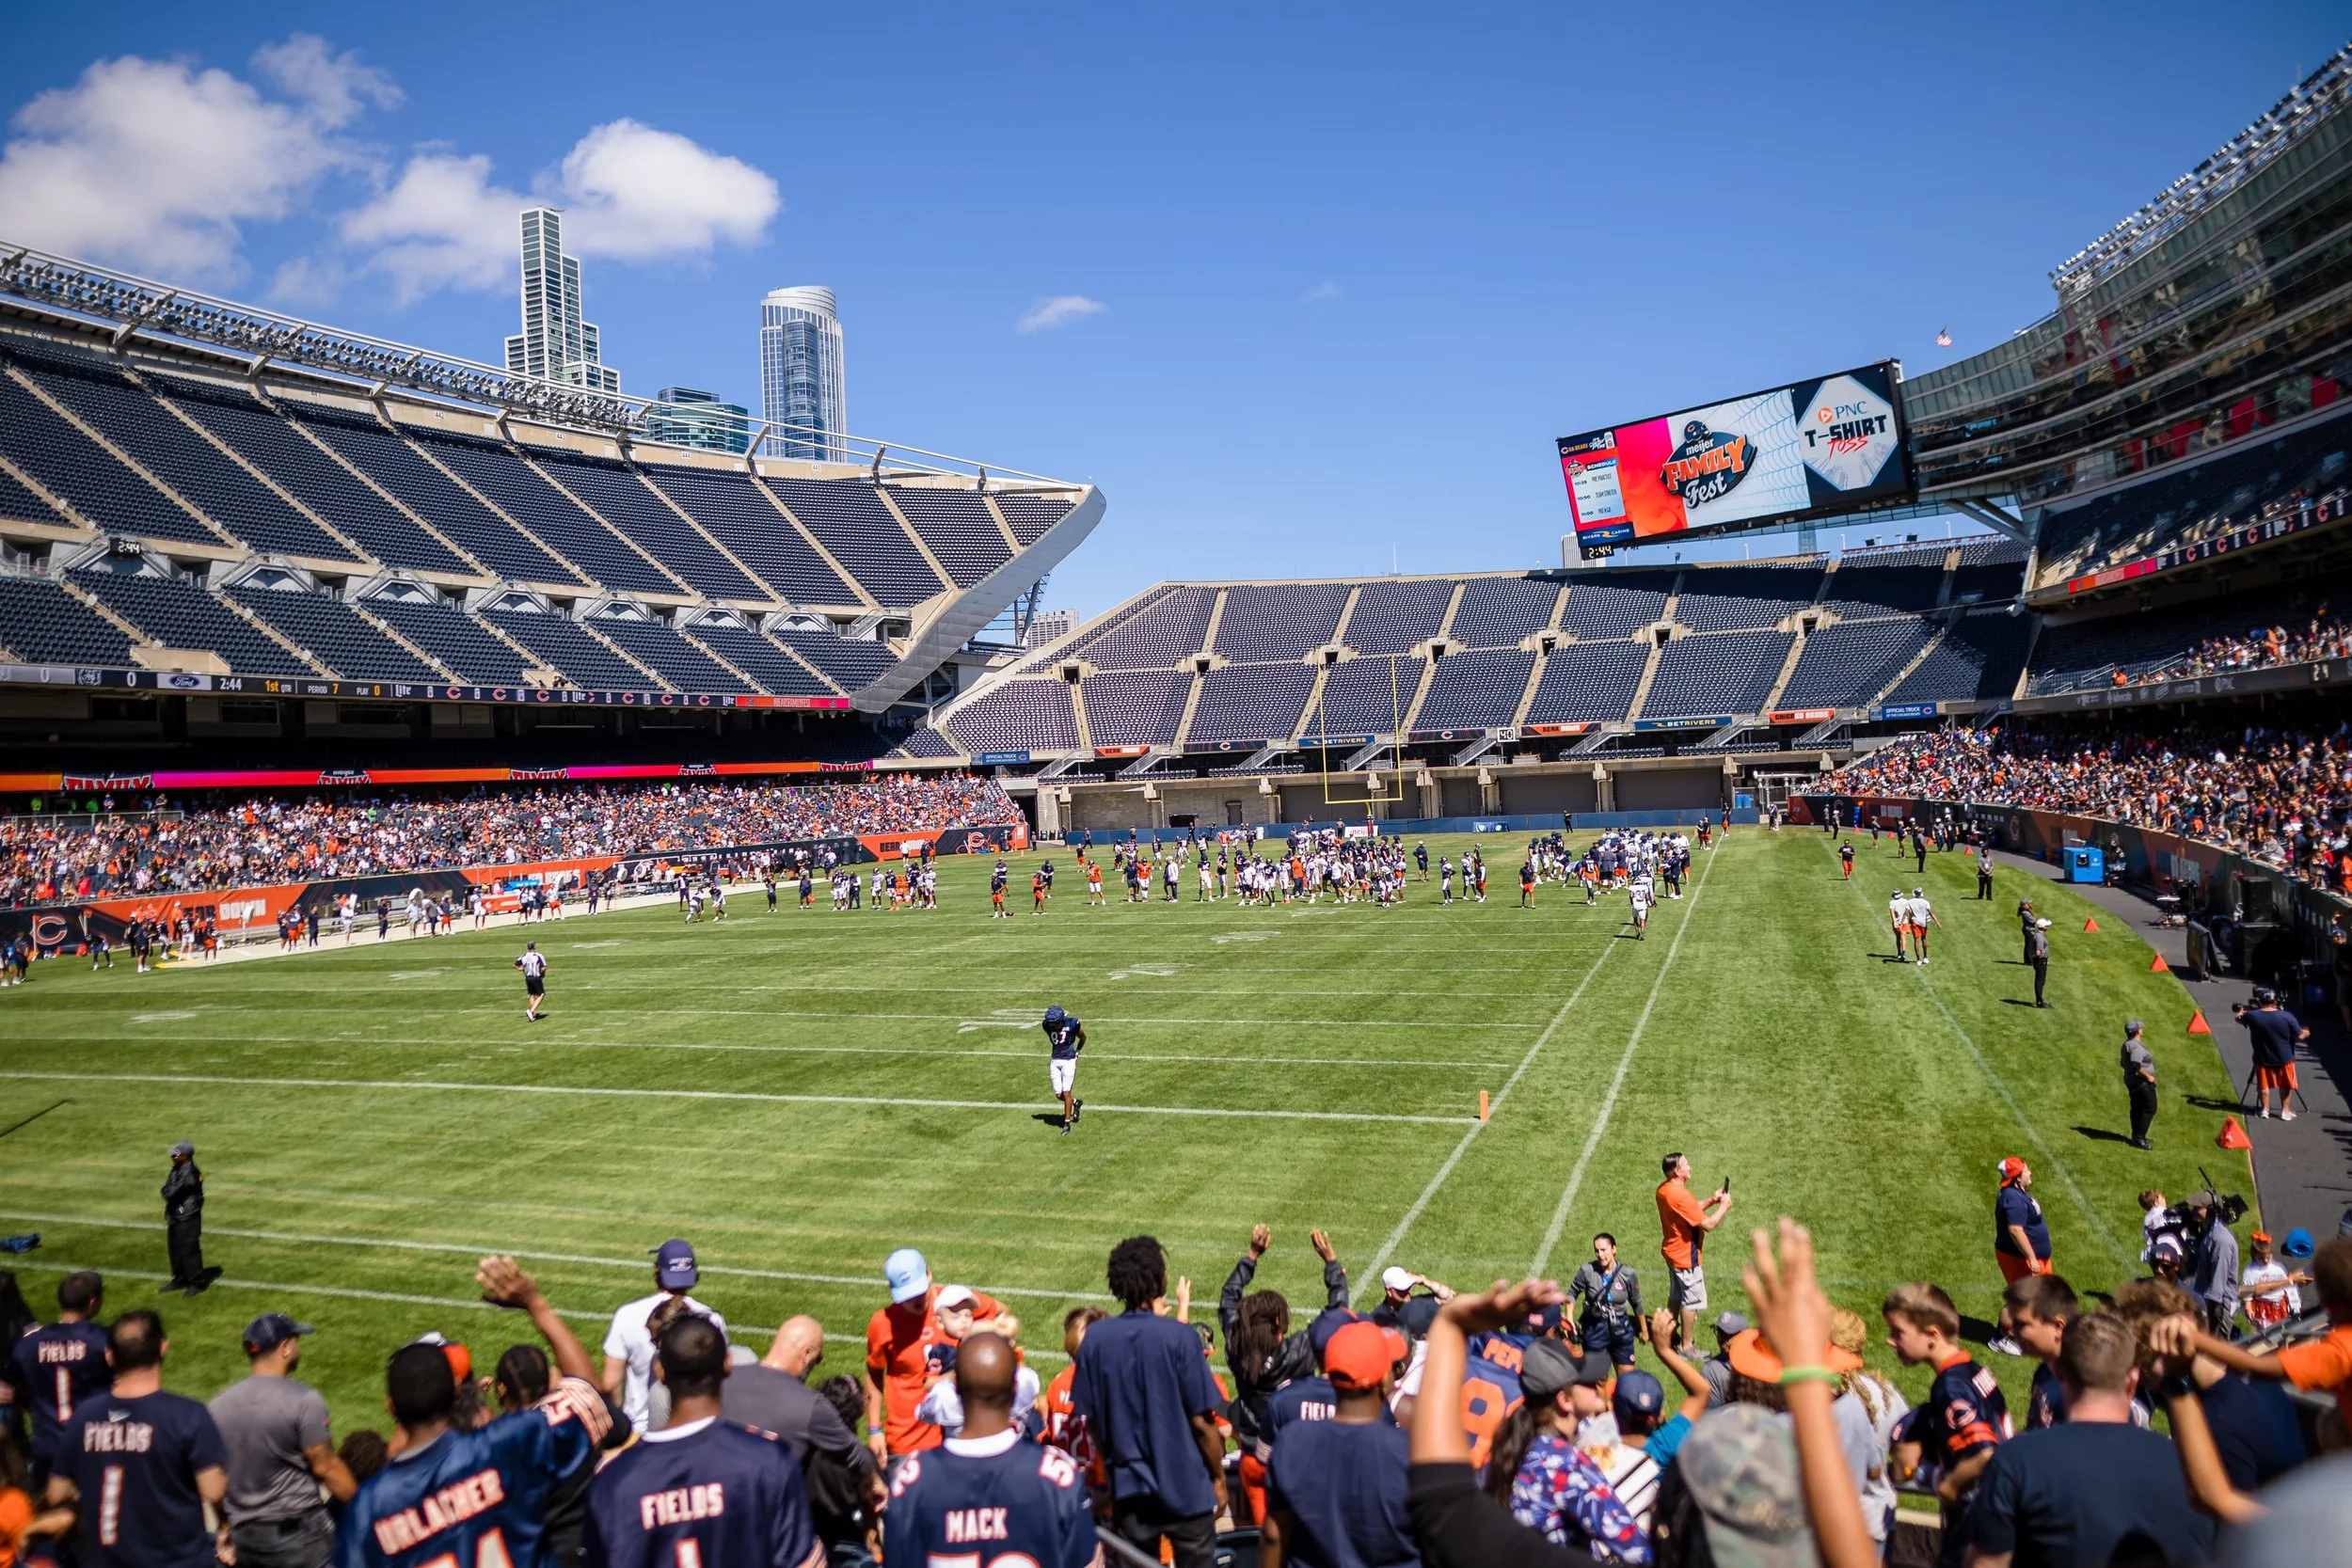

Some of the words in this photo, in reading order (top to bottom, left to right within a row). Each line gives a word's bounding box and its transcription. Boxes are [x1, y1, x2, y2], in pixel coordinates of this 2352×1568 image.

[1835, 401, 1867, 419] PNC
[1804, 415, 1886, 448] T-SHIRT
[1686, 437, 1713, 455] meijer
[1827, 433, 1868, 459] TOSS
[1587, 459, 1616, 469] SCHEDULE
[1662, 436, 1746, 490] FAMILY
[1685, 471, 1727, 508] Fest
[118, 541, 140, 553] 2:44
[1588, 546, 1612, 559] 2:44
[40, 668, 50, 683] 0
[126, 672, 136, 688] 0
[175, 675, 194, 687] Ford
[220, 678, 243, 690] 2:44
[264, 680, 278, 691] 1st
[308, 685, 327, 694] PERIOD
[332, 683, 339, 694] 7
[357, 687, 369, 695] PLAY
[373, 685, 380, 696] 0
[395, 684, 411, 697] Lite
[572, 691, 586, 703] Lite
[723, 696, 734, 706] Lite
[1667, 719, 1716, 727] BETRIVERS
[1775, 712, 1804, 721] CHICAGO
[1500, 730, 1513, 740] 40
[183, 905, 215, 921] EAR
[39, 1340, 87, 1363] FIELDS
[55, 1366, 72, 1422] 1
[1300, 1401, 1336, 1421] FIELD
[84, 1420, 153, 1453] FIELDS
[98, 1465, 124, 1547] 1
[373, 1468, 505, 1556] URLACHER
[640, 1482, 723, 1530] FIELDS
[946, 1507, 1008, 1543] MACK
